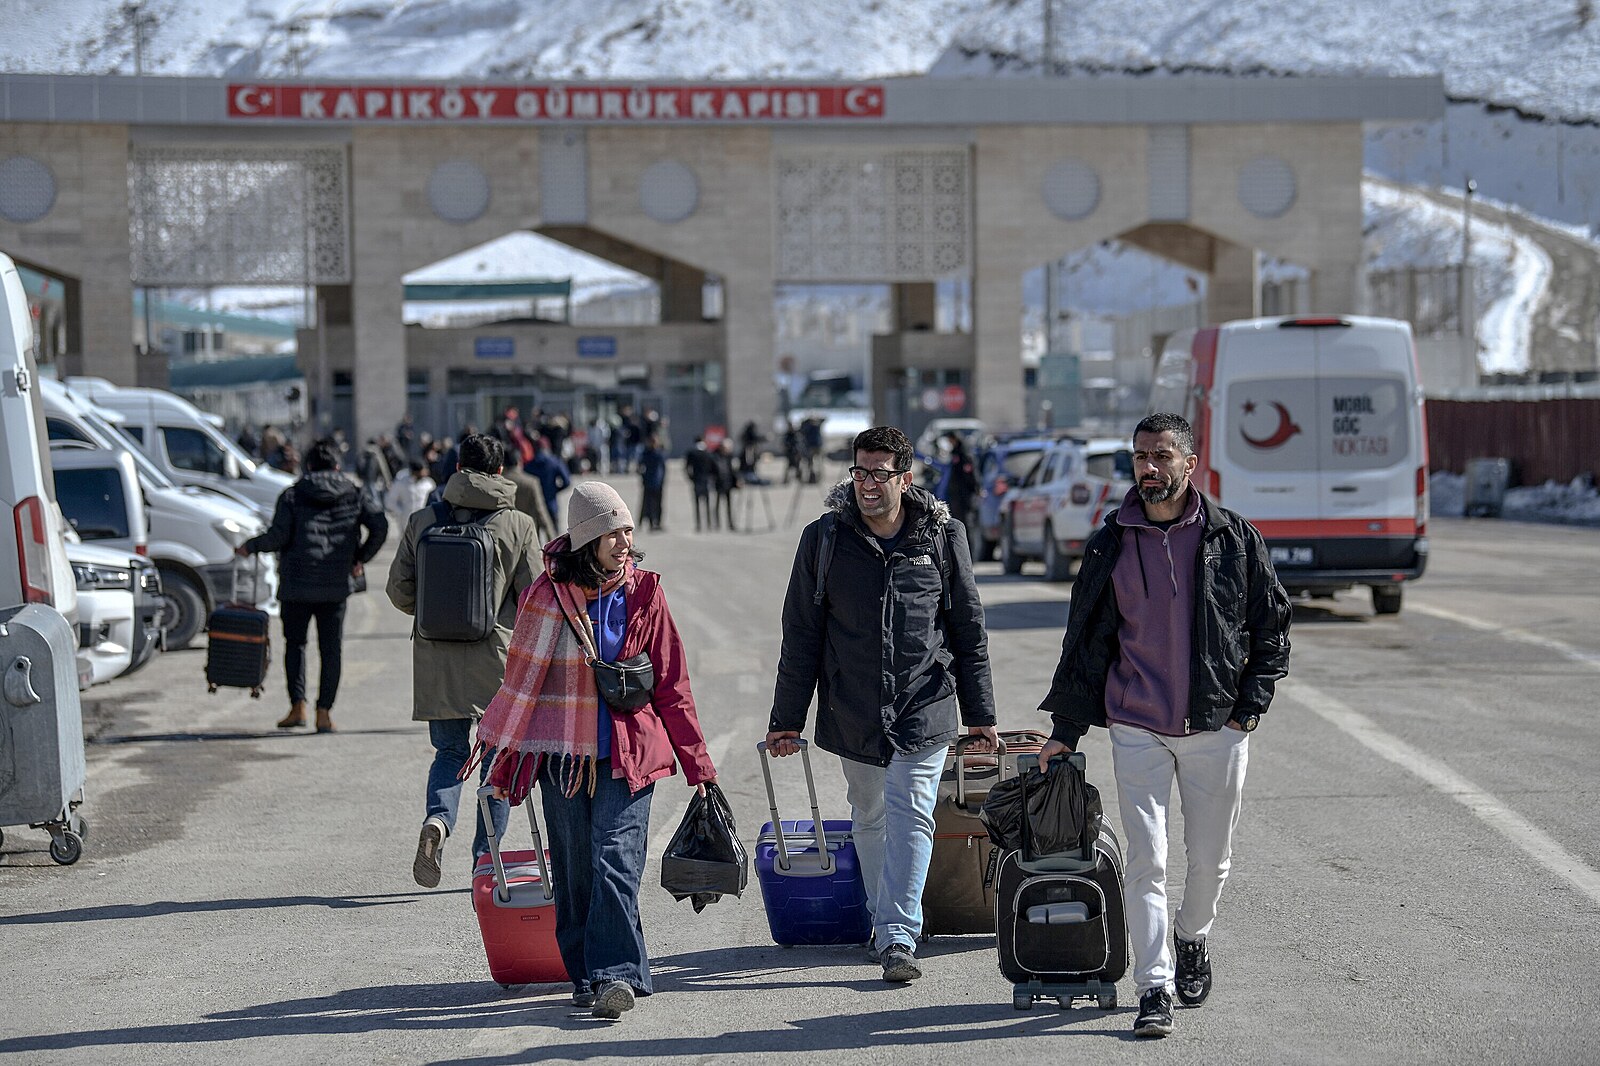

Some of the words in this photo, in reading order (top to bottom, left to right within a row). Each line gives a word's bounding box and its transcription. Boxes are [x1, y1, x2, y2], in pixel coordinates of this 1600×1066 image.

[301, 86, 496, 119] KAPIKÖY
[514, 87, 679, 119] GÜMRÜK
[690, 91, 818, 119] KAPISI
